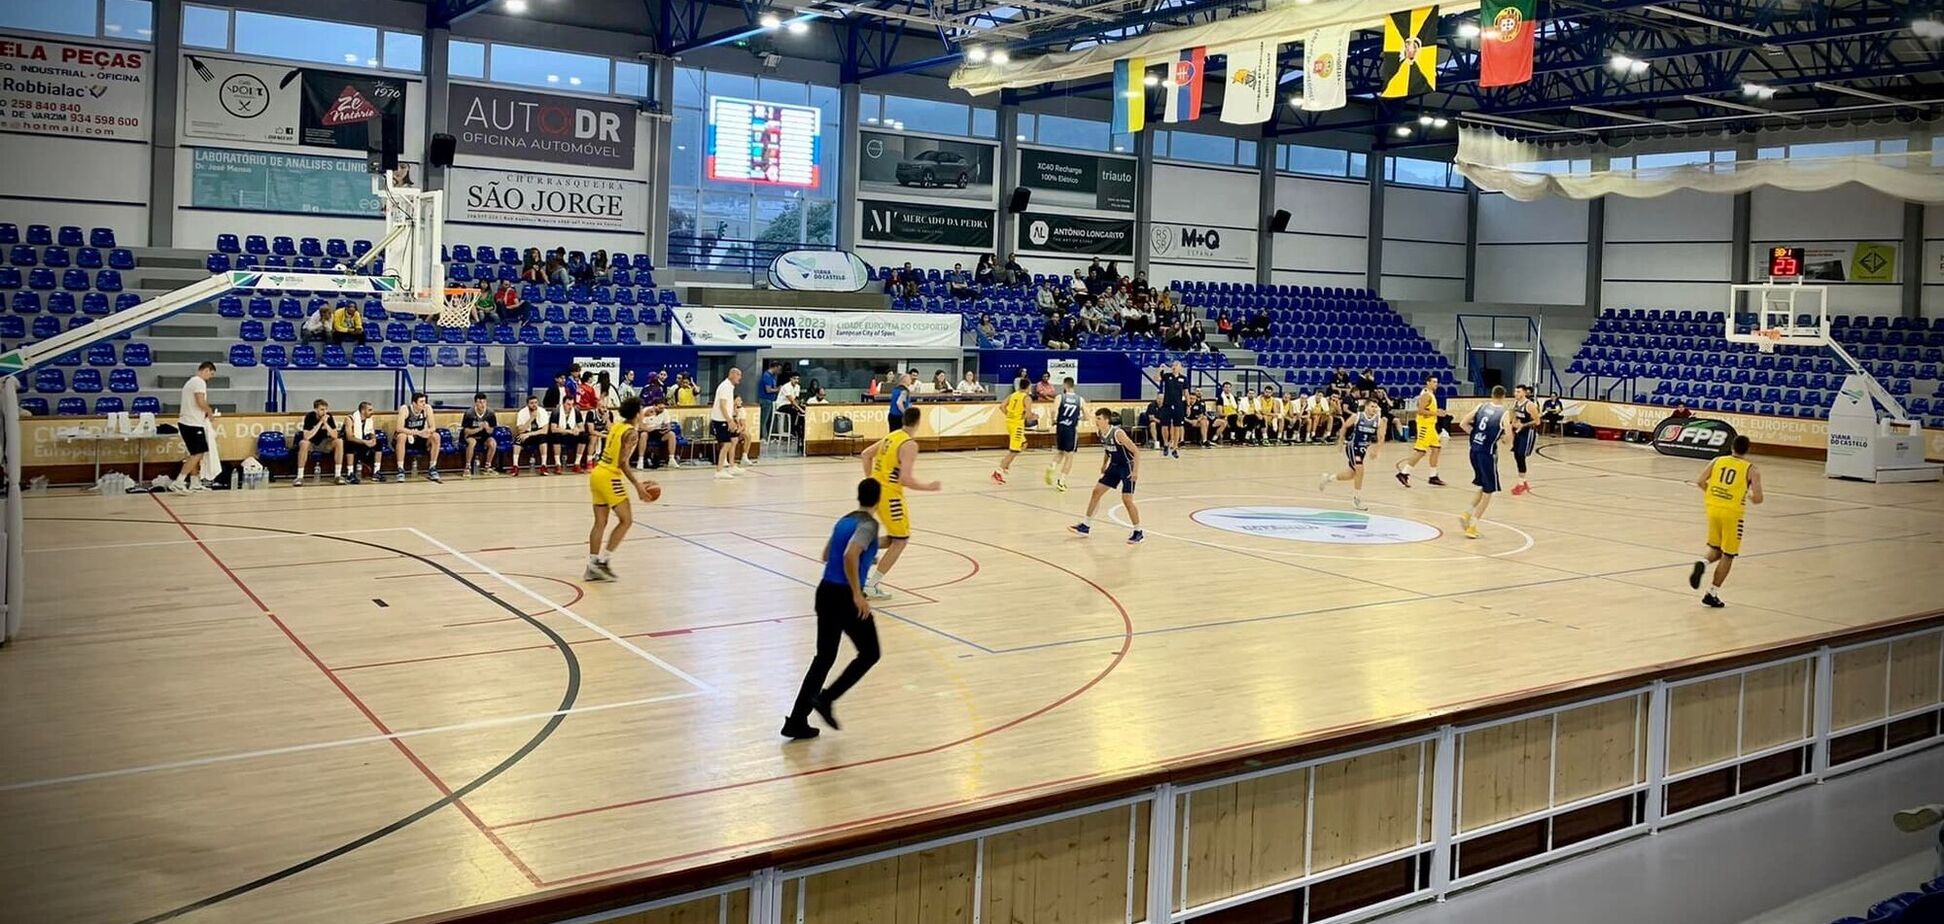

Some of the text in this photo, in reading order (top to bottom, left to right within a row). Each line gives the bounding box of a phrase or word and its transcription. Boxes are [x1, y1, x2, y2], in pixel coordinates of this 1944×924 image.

[62, 47, 142, 70] PEÇAS
[20, 64, 87, 78] INDUSTRIAL
[96, 71, 141, 82] OFICINA
[3, 77, 86, 97] Robbialac
[374, 87, 401, 98] 1970
[11, 98, 33, 109] 258
[35, 101, 57, 111] 840
[60, 103, 82, 113] 840
[338, 92, 363, 111] Zé
[11, 110, 26, 119] DE
[70, 113, 91, 123] 934
[94, 115, 116, 126] 598
[117, 117, 139, 127] 600
[330, 108, 375, 122] Natário
[462, 131, 621, 158] OFICINA AUTOMÓVEL
[270, 156, 283, 167] DE
[1037, 162, 1083, 175] XC40 Recharge
[506, 174, 624, 190] CHURRASQUEIRA
[1041, 173, 1057, 182] 100%
[1102, 170, 1132, 183] triauto
[467, 181, 623, 216] SÃO JORGE
[902, 214, 989, 229] MERCADO DA PEDRA
[1774, 259, 1796, 275] 23
[759, 316, 826, 328] VIANA 2023
[758, 328, 825, 339] DO CASTELO
[1063, 403, 1077, 417] 77
[235, 422, 264, 438] DO
[1479, 416, 1488, 431] 6
[1750, 418, 1807, 433] EUROPEIA
[1678, 427, 1728, 446] FPB
[1840, 439, 1868, 449] CASTELO
[1720, 466, 1736, 485] 10
